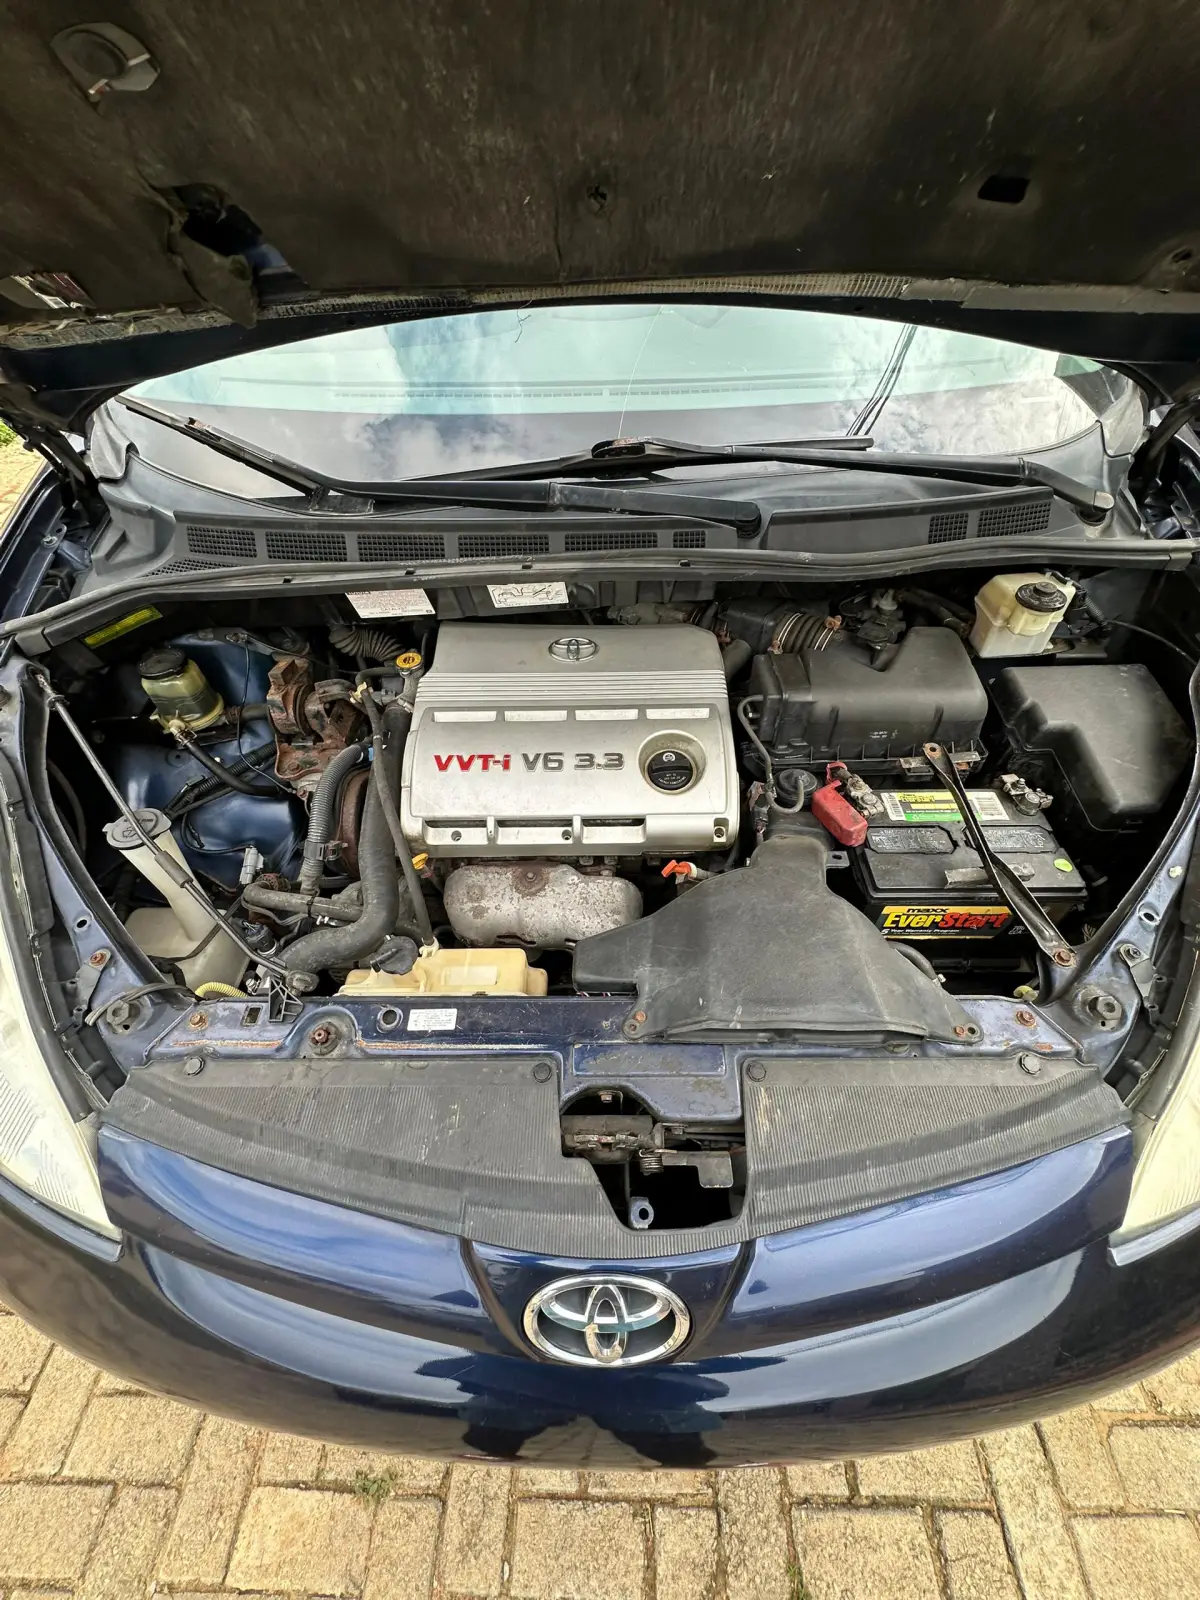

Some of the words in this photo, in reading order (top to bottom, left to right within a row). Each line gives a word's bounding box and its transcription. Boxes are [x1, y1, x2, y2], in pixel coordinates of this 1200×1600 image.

[433, 754, 512, 772] VVT-i
[521, 752, 565, 772] V6
[573, 752, 625, 771] 3.3
[883, 912, 1010, 928] EverStart
